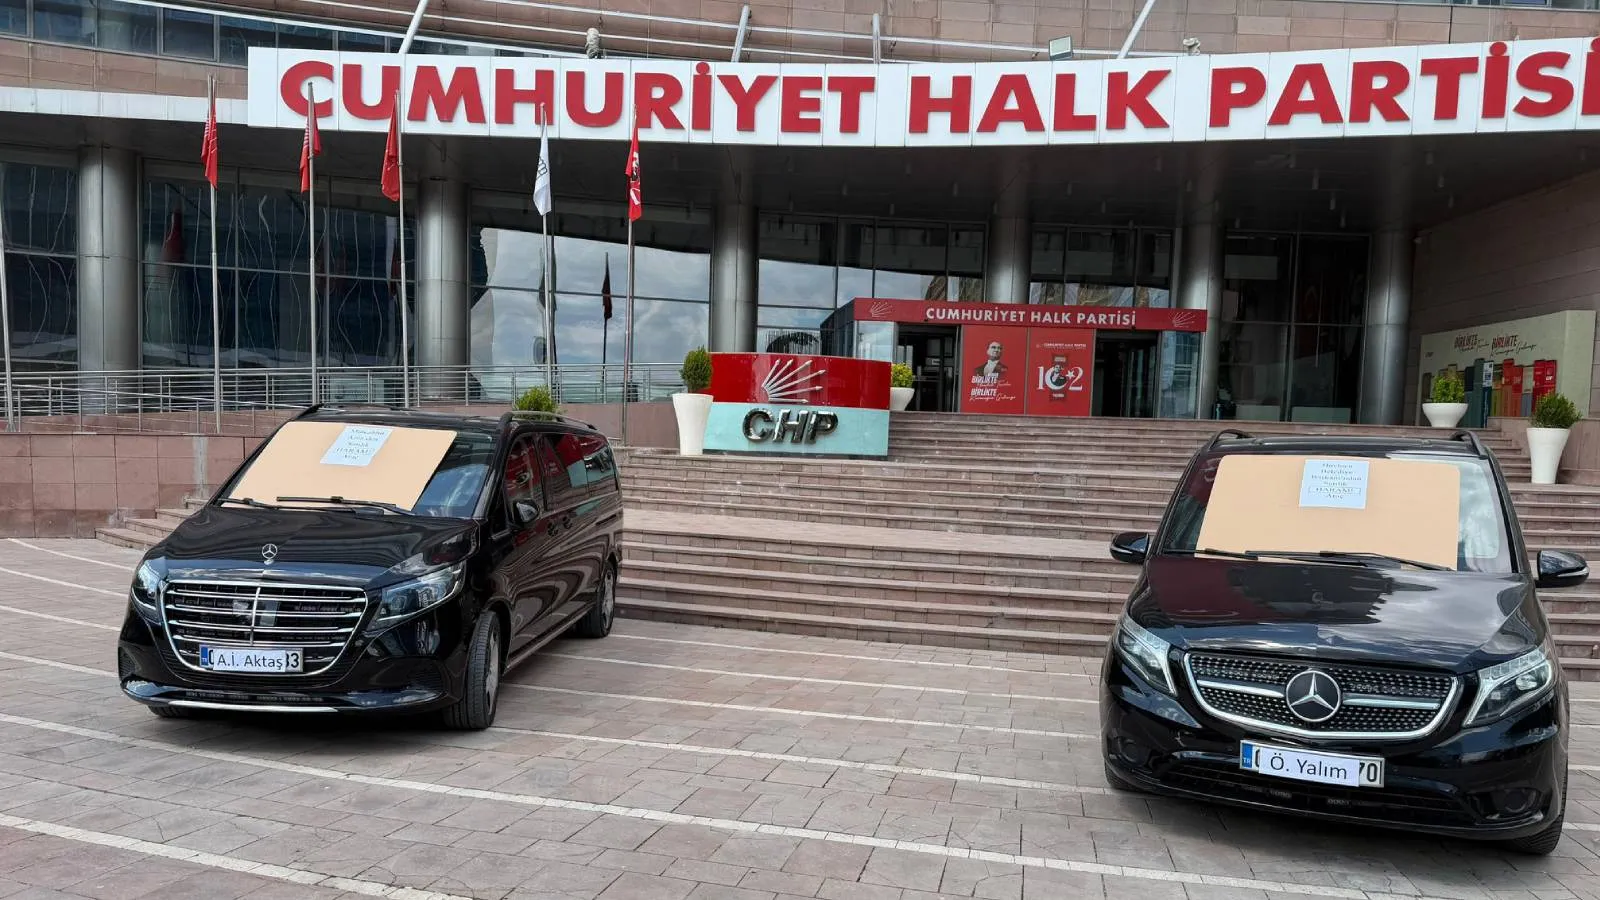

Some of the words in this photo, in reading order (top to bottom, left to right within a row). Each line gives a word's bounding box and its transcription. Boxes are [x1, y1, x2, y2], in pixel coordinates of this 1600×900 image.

[281, 61, 875, 133] CUMHURİYET
[910, 71, 1168, 133] HALK
[1210, 37, 1600, 127] PARTİSİ
[926, 307, 1025, 322] CUMHURİYET
[1031, 311, 1071, 324] HALK
[1077, 310, 1136, 325] PARTİSİ
[743, 408, 839, 444] CHP
[243, 654, 283, 670] Aktaş
[1270, 752, 1289, 771] Ö.
[1296, 759, 1347, 779] Yalım
